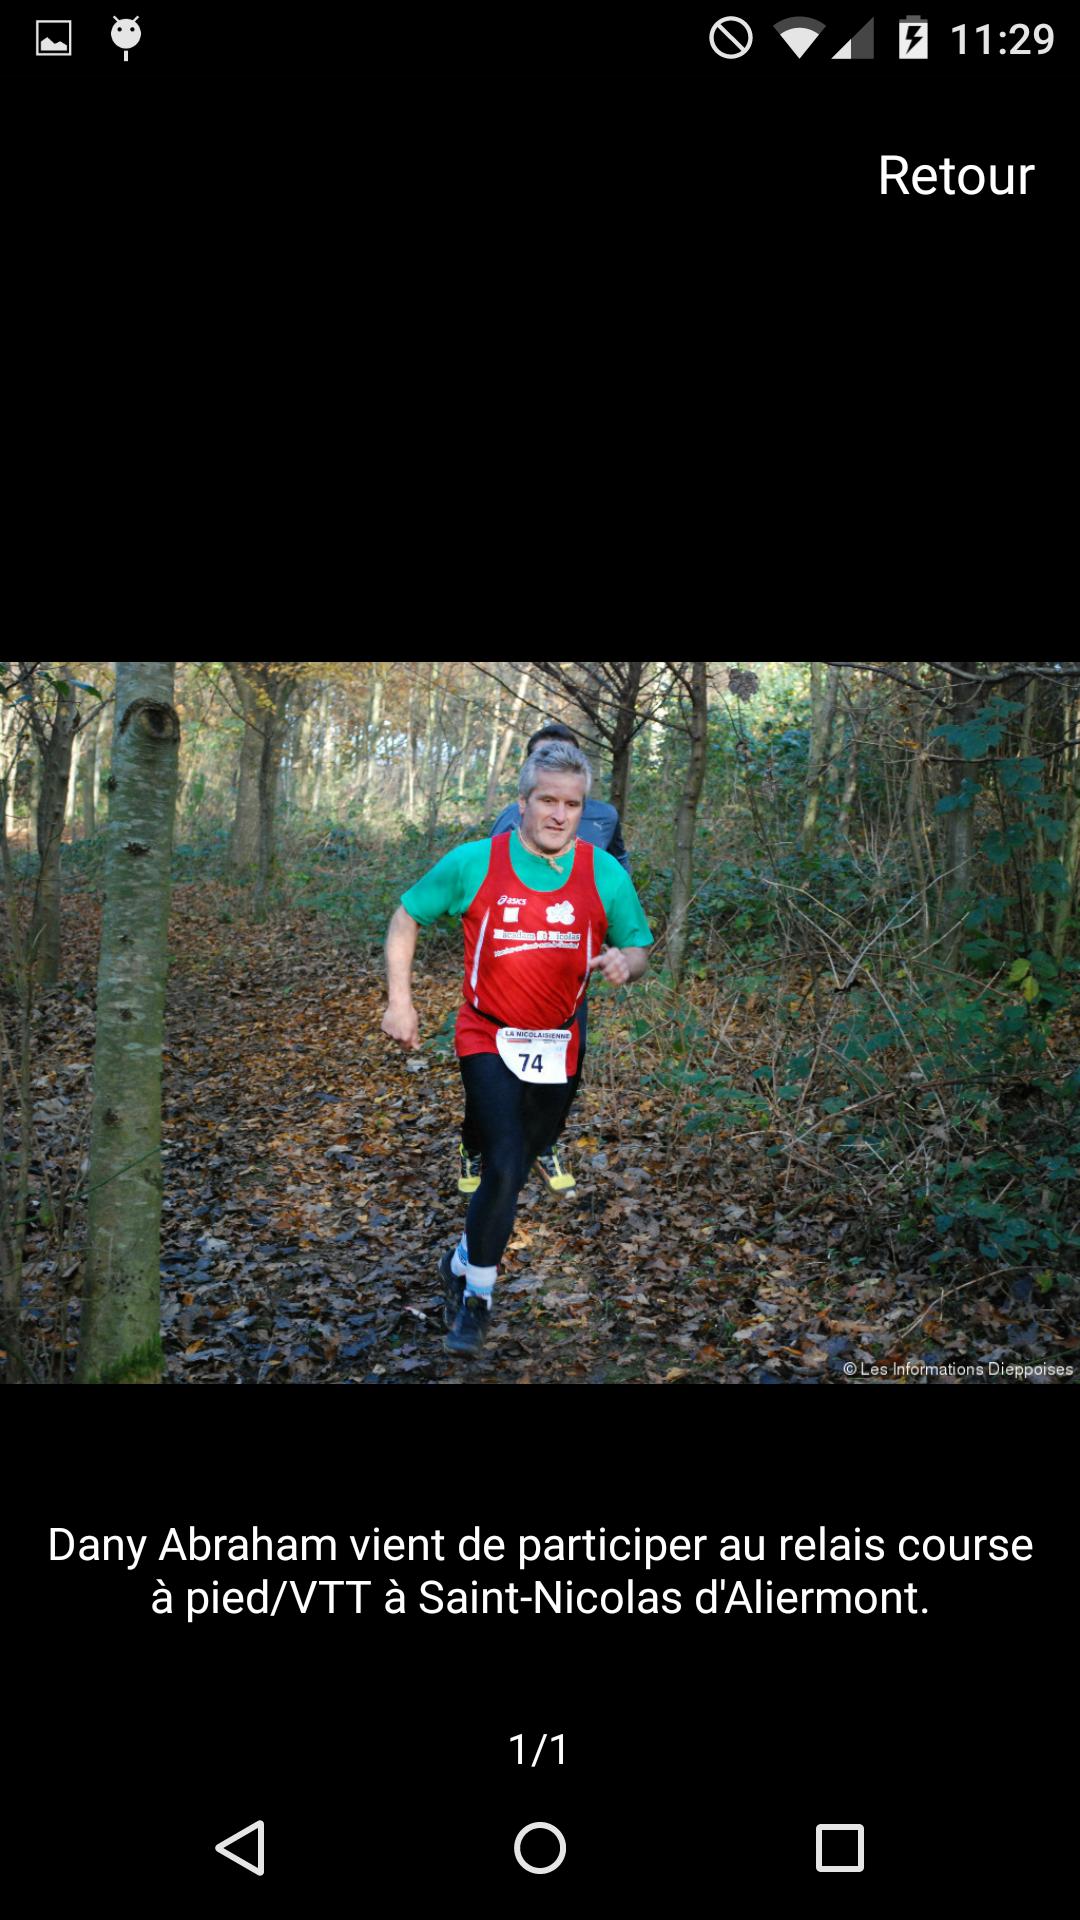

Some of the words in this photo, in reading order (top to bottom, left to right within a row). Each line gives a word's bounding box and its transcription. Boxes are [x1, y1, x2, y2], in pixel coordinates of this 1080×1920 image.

[951, 24, 1054, 54] 11:29
[880, 155, 1036, 196] Retour
[493, 929, 536, 941] acadam
[537, 930, 548, 941] t
[549, 931, 581, 942] icolas
[517, 1031, 570, 1039] NICOLAISIENNE
[518, 1054, 544, 1073] 74
[49, 1527, 148, 1570] Dany
[159, 1526, 337, 1562] Abraham
[350, 1526, 445, 1562] vient
[458, 1526, 505, 1562] de
[519, 1527, 708, 1570] participer
[720, 1535, 765, 1562] au
[780, 1526, 885, 1562] relais
[898, 1535, 1033, 1562] course
[152, 1579, 173, 1615] à
[188, 1579, 372, 1623] pied/VTT
[384, 1579, 406, 1615] à
[419, 1579, 682, 1615] Saint-Nicolas
[695, 1579, 929, 1615] d'Aliermont.
[510, 1733, 564, 1768] 1/1
